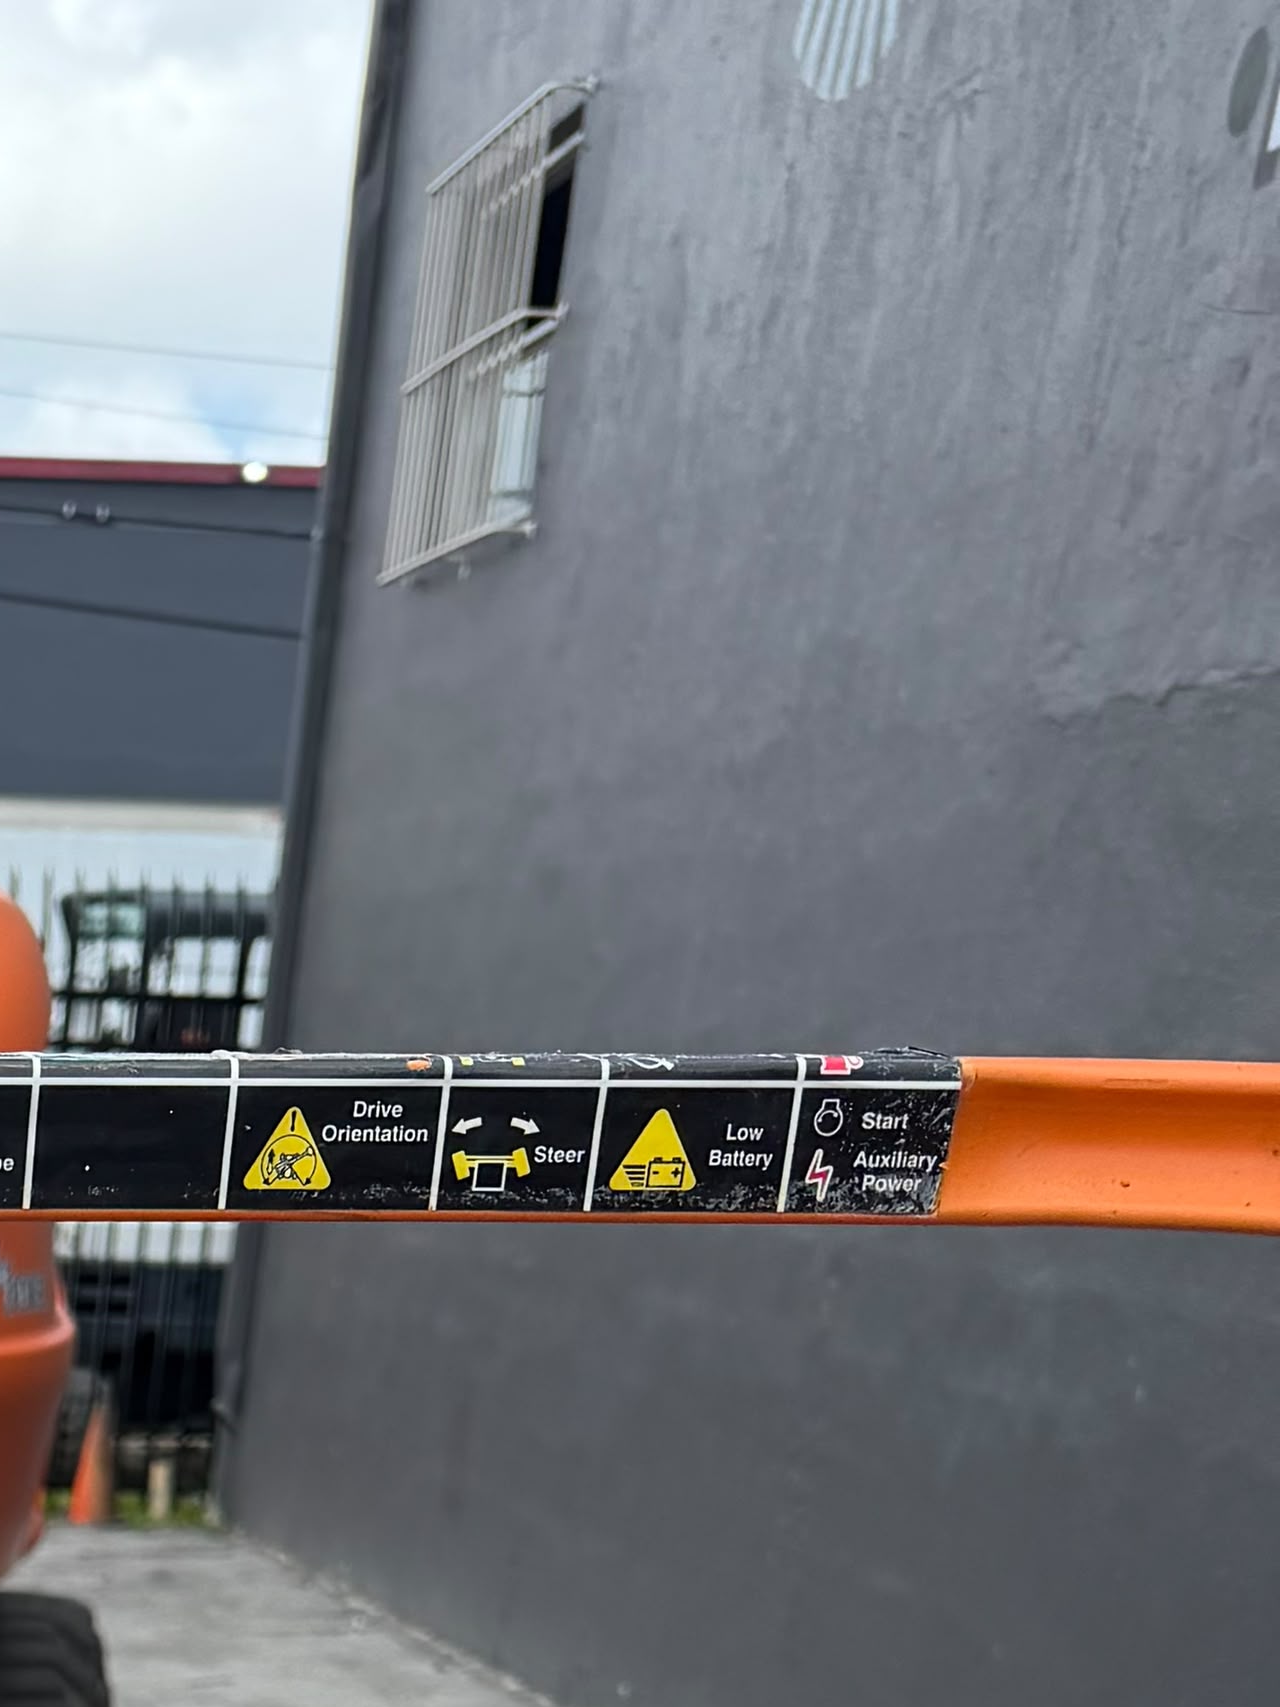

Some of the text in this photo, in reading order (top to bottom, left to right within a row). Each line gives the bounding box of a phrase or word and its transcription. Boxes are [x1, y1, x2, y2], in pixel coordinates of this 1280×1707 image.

[354, 1101, 402, 1117] Drive
[862, 1112, 908, 1129] Start
[322, 1125, 427, 1142] Orientation
[727, 1124, 763, 1140] Low
[535, 1146, 585, 1162] Steer
[709, 1150, 773, 1170] Battery
[854, 1151, 937, 1175] Auxiliary
[862, 1173, 922, 1197] Power
